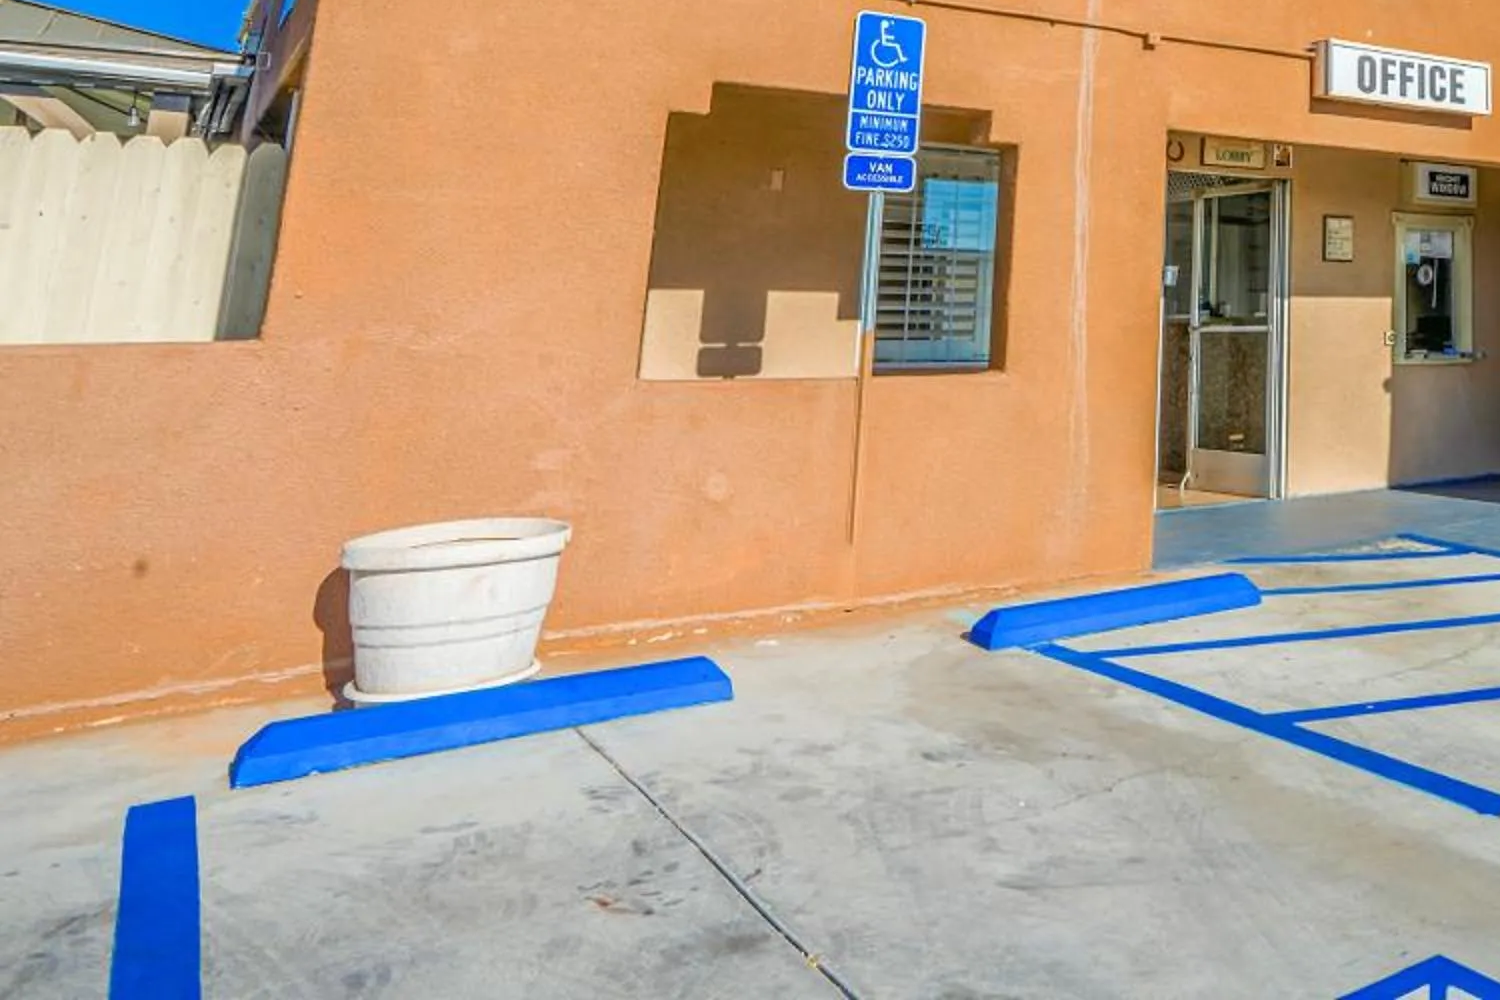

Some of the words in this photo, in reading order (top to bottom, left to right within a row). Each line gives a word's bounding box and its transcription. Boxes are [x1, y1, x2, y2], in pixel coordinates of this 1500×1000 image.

[856, 66, 919, 91] PARKING
[1357, 55, 1466, 105] OFFICE
[866, 90, 906, 112] ONLY
[859, 116, 909, 133] MINIMUM
[855, 131, 880, 146] FINE
[882, 132, 911, 149] $250
[868, 161, 894, 174] VAN
